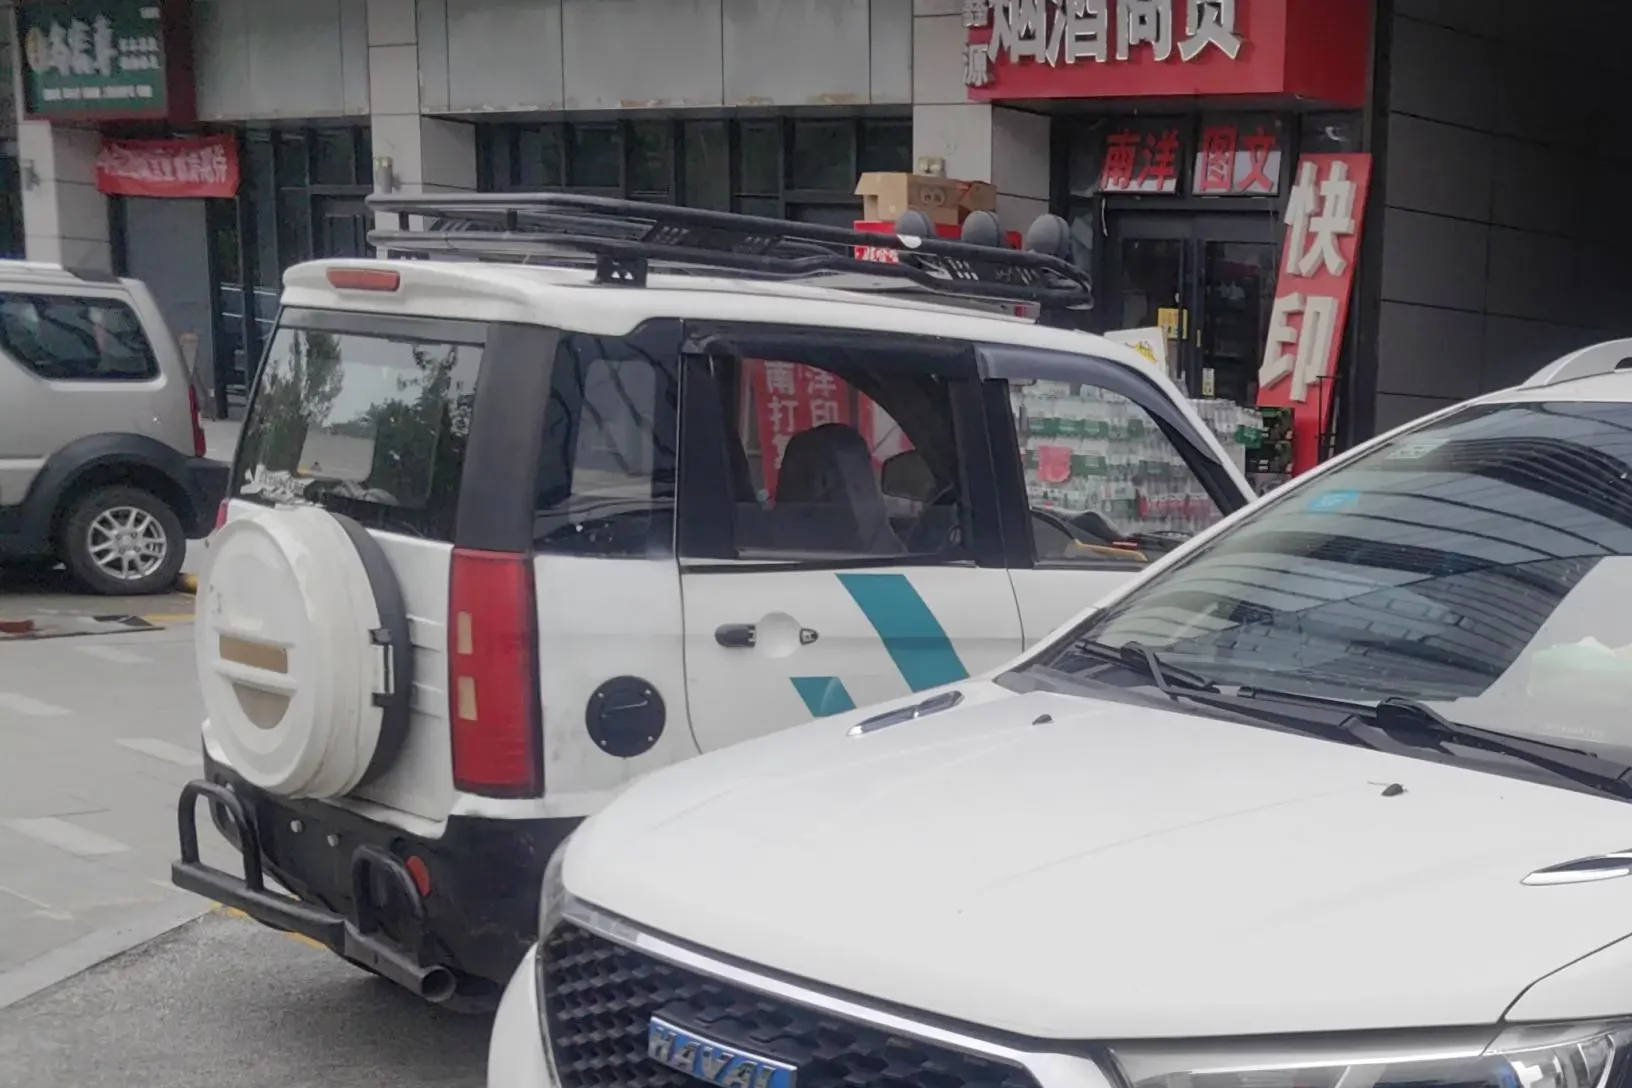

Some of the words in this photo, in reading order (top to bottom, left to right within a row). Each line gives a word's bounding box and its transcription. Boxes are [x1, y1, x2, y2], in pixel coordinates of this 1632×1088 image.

[1102, 130, 1180, 190] 南洋
[1202, 126, 1277, 191] 图文
[1259, 160, 1356, 403] 快印
